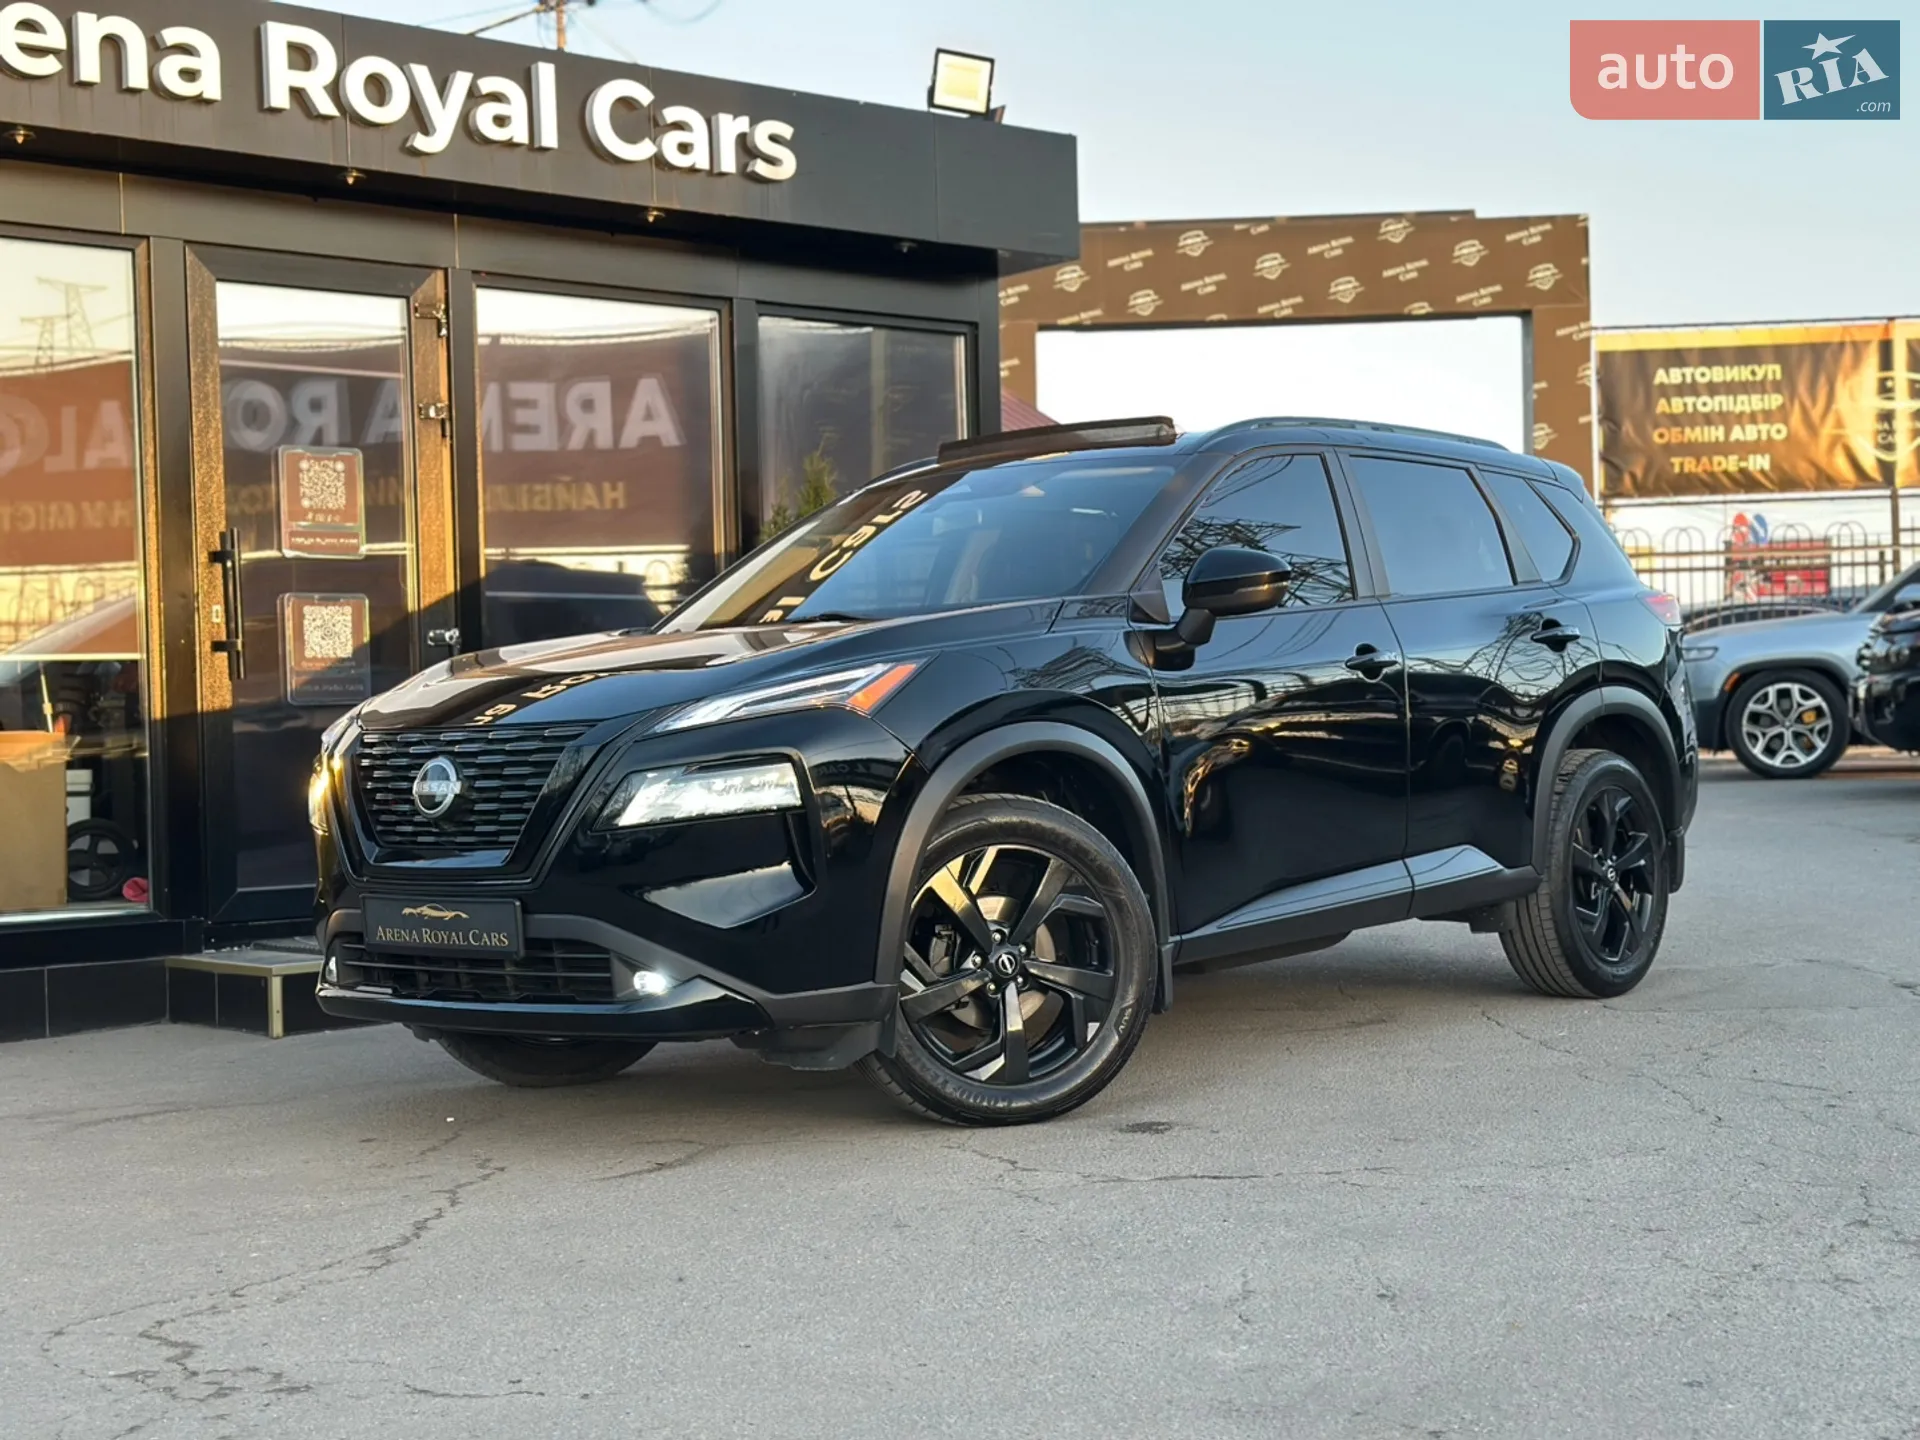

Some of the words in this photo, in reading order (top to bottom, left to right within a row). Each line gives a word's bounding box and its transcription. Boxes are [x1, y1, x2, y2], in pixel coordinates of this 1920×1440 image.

[260, 21, 558, 155] Royal
[586, 78, 798, 183] Cars
[1653, 363, 1783, 386] АВТОВИКУП
[1655, 393, 1784, 415] АВТОПІДБІР
[1653, 424, 1726, 445] ОБМІН
[1729, 422, 1788, 443] АВТО
[1670, 453, 1771, 474] TRADE-IN
[376, 925, 420, 943] ARENA
[422, 927, 468, 946] ROYAL
[469, 929, 510, 947] CARS
